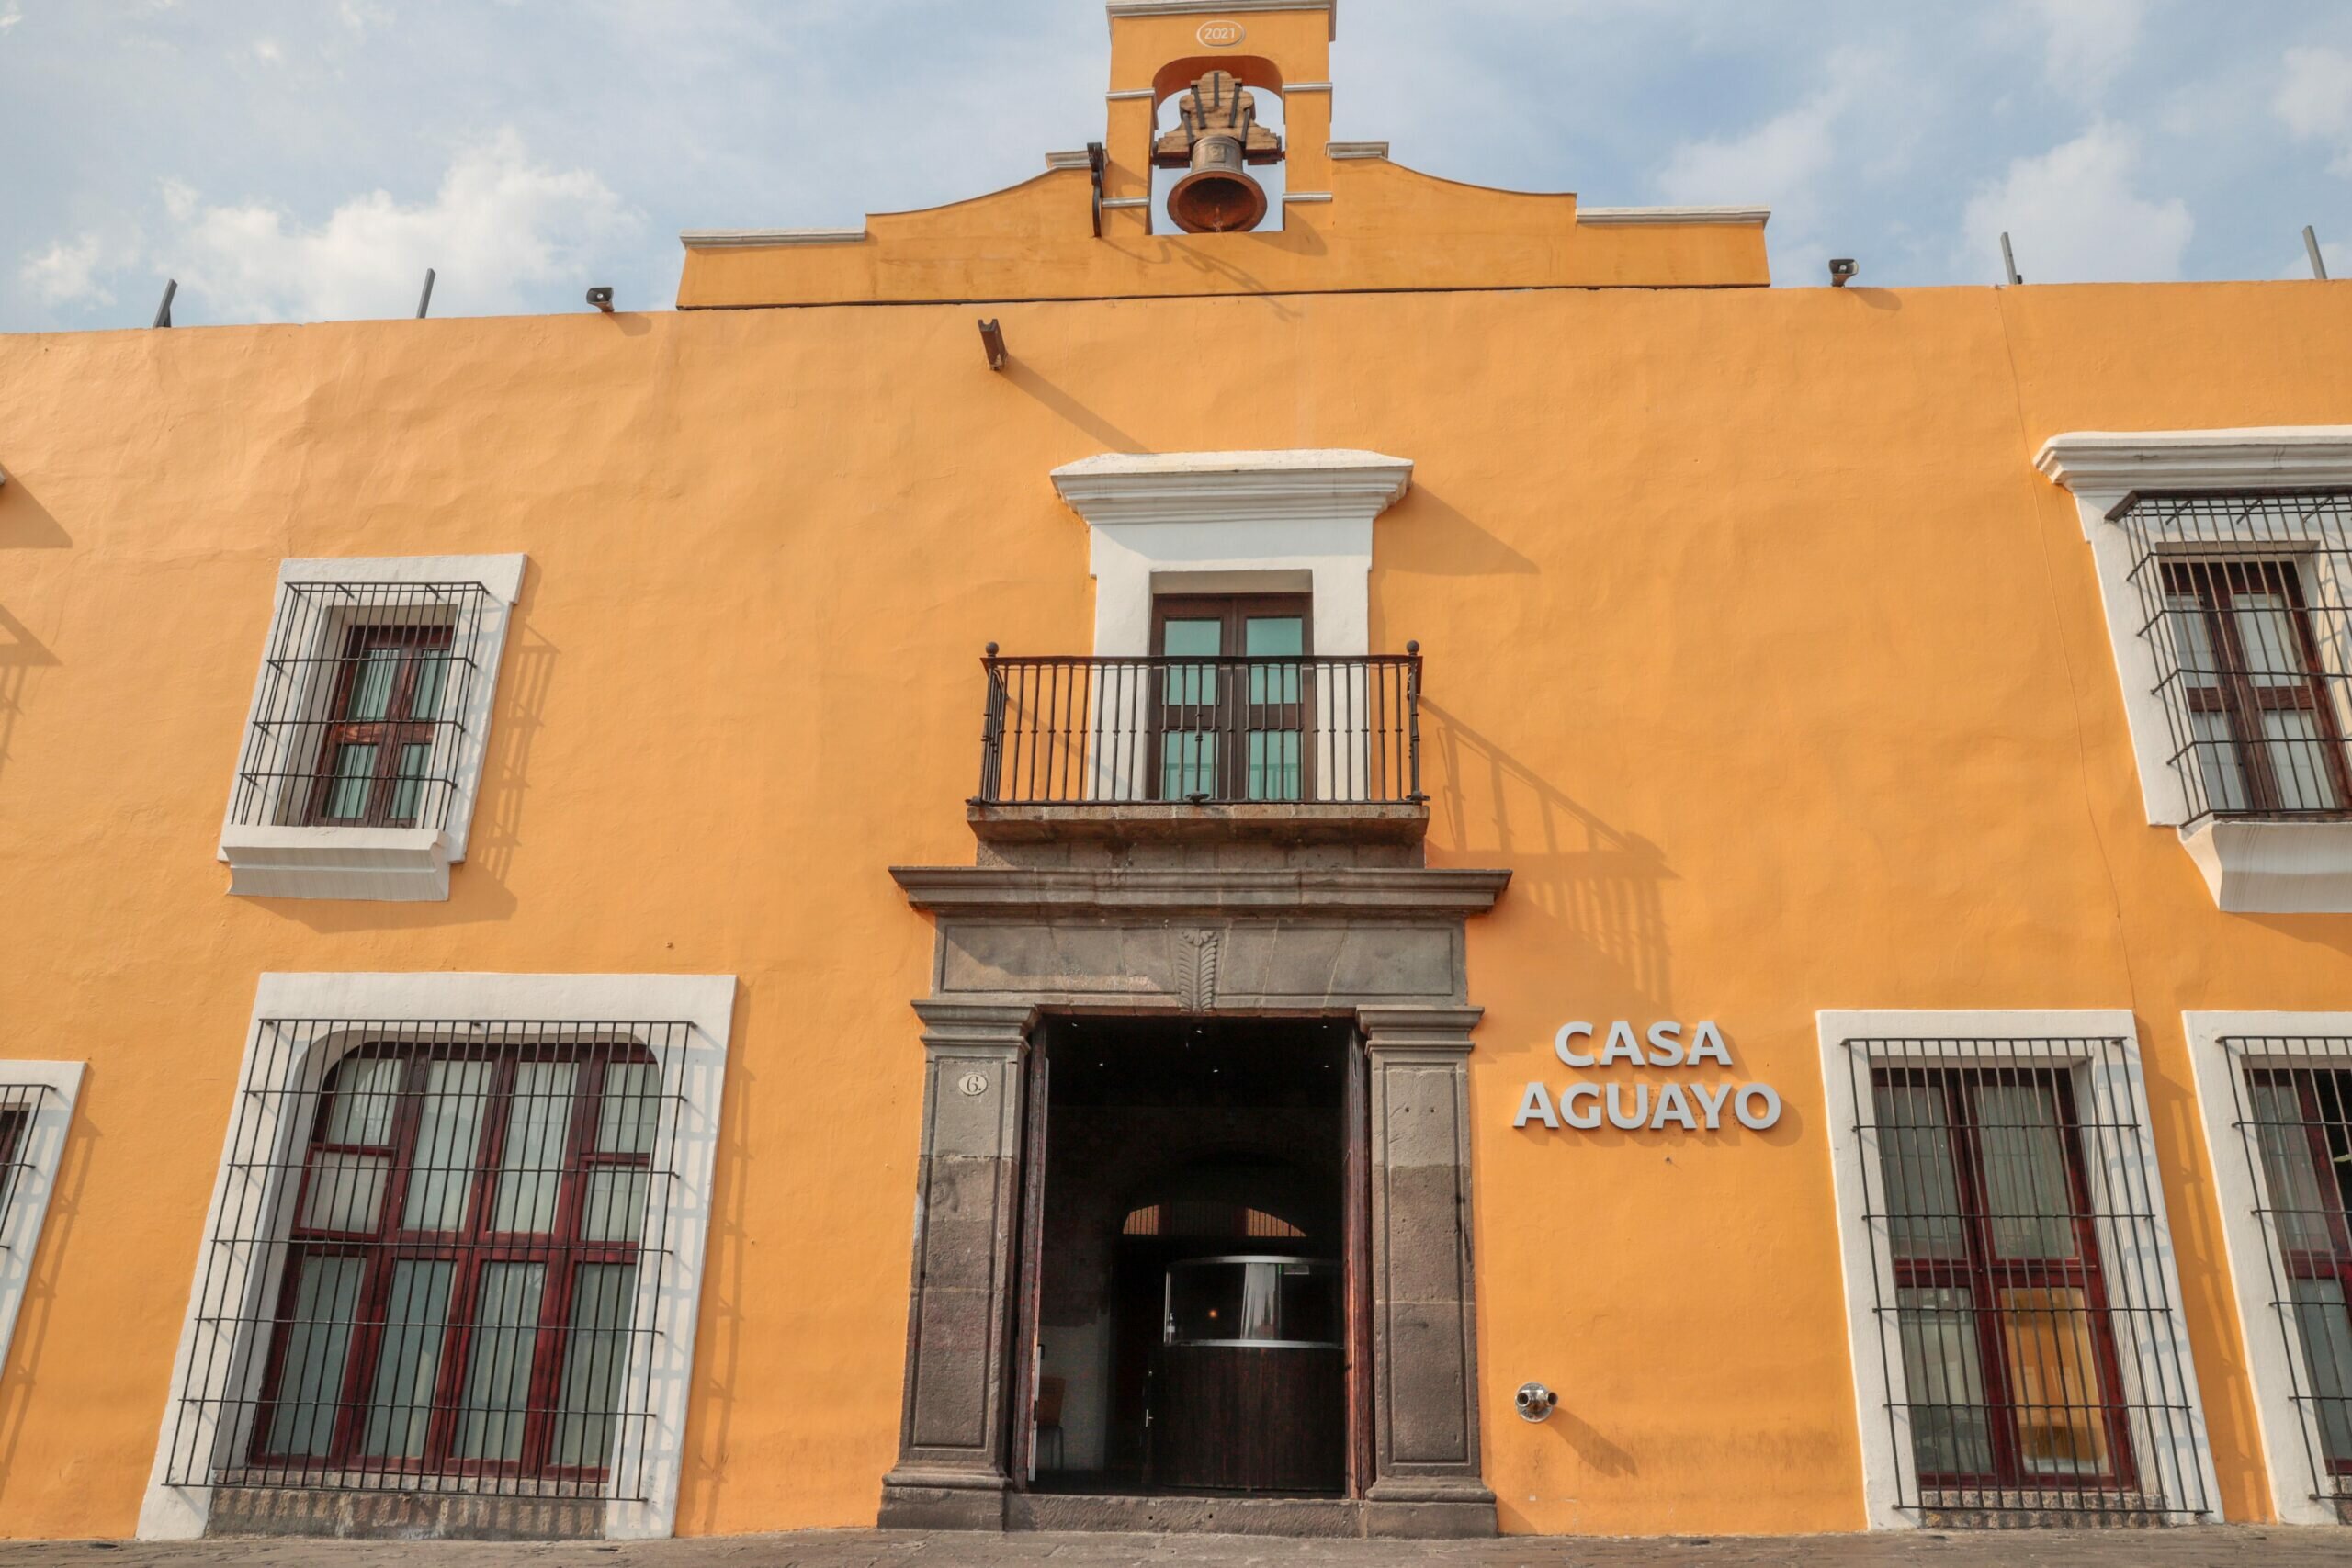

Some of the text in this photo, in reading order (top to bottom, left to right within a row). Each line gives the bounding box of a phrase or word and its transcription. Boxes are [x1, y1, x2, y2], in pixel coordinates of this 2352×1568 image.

[1204, 28, 1236, 39] 2021
[1555, 1021, 1734, 1067] CASA
[1512, 1081, 1781, 1130] AGUAYO
